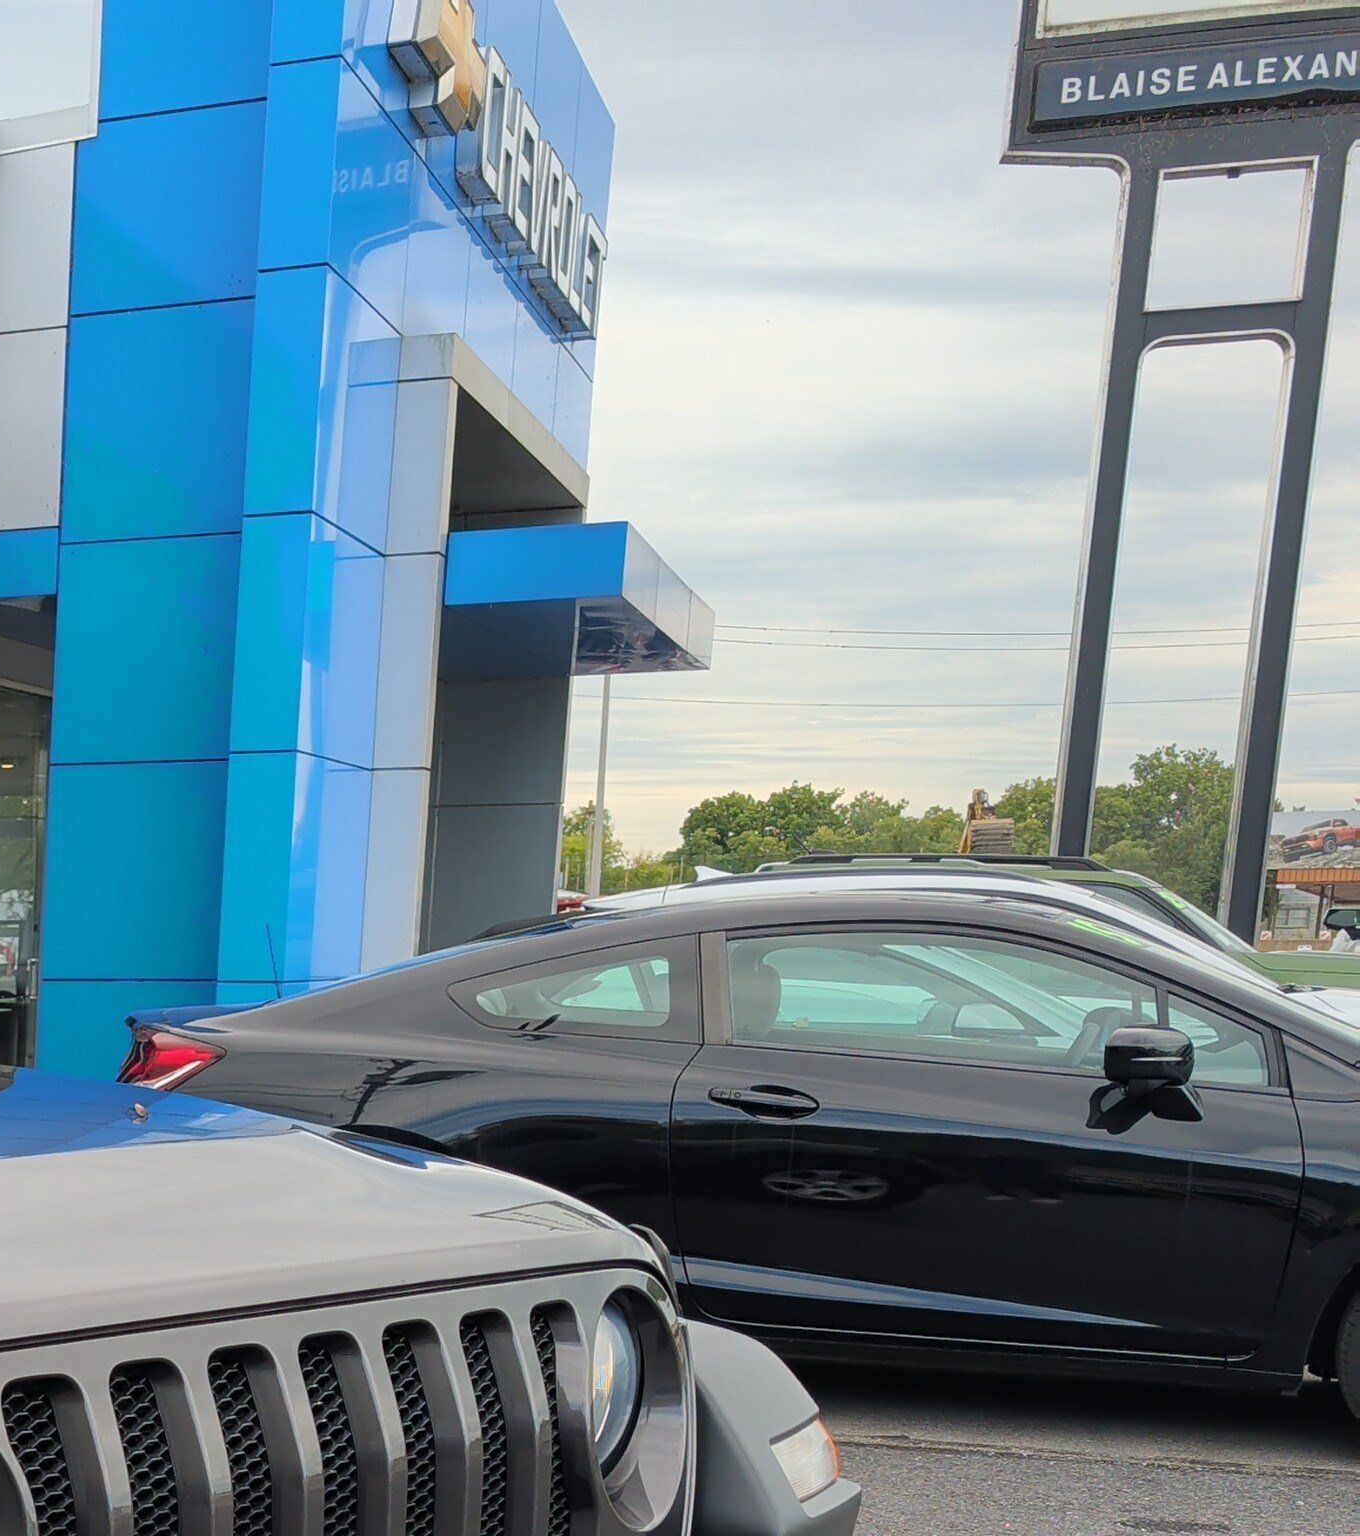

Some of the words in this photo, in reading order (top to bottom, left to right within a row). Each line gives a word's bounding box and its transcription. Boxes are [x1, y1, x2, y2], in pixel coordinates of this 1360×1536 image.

[1060, 65, 1198, 104] BLAISE
[1206, 50, 1358, 90] ALEXAN
[478, 44, 609, 341] CHEVROLET
